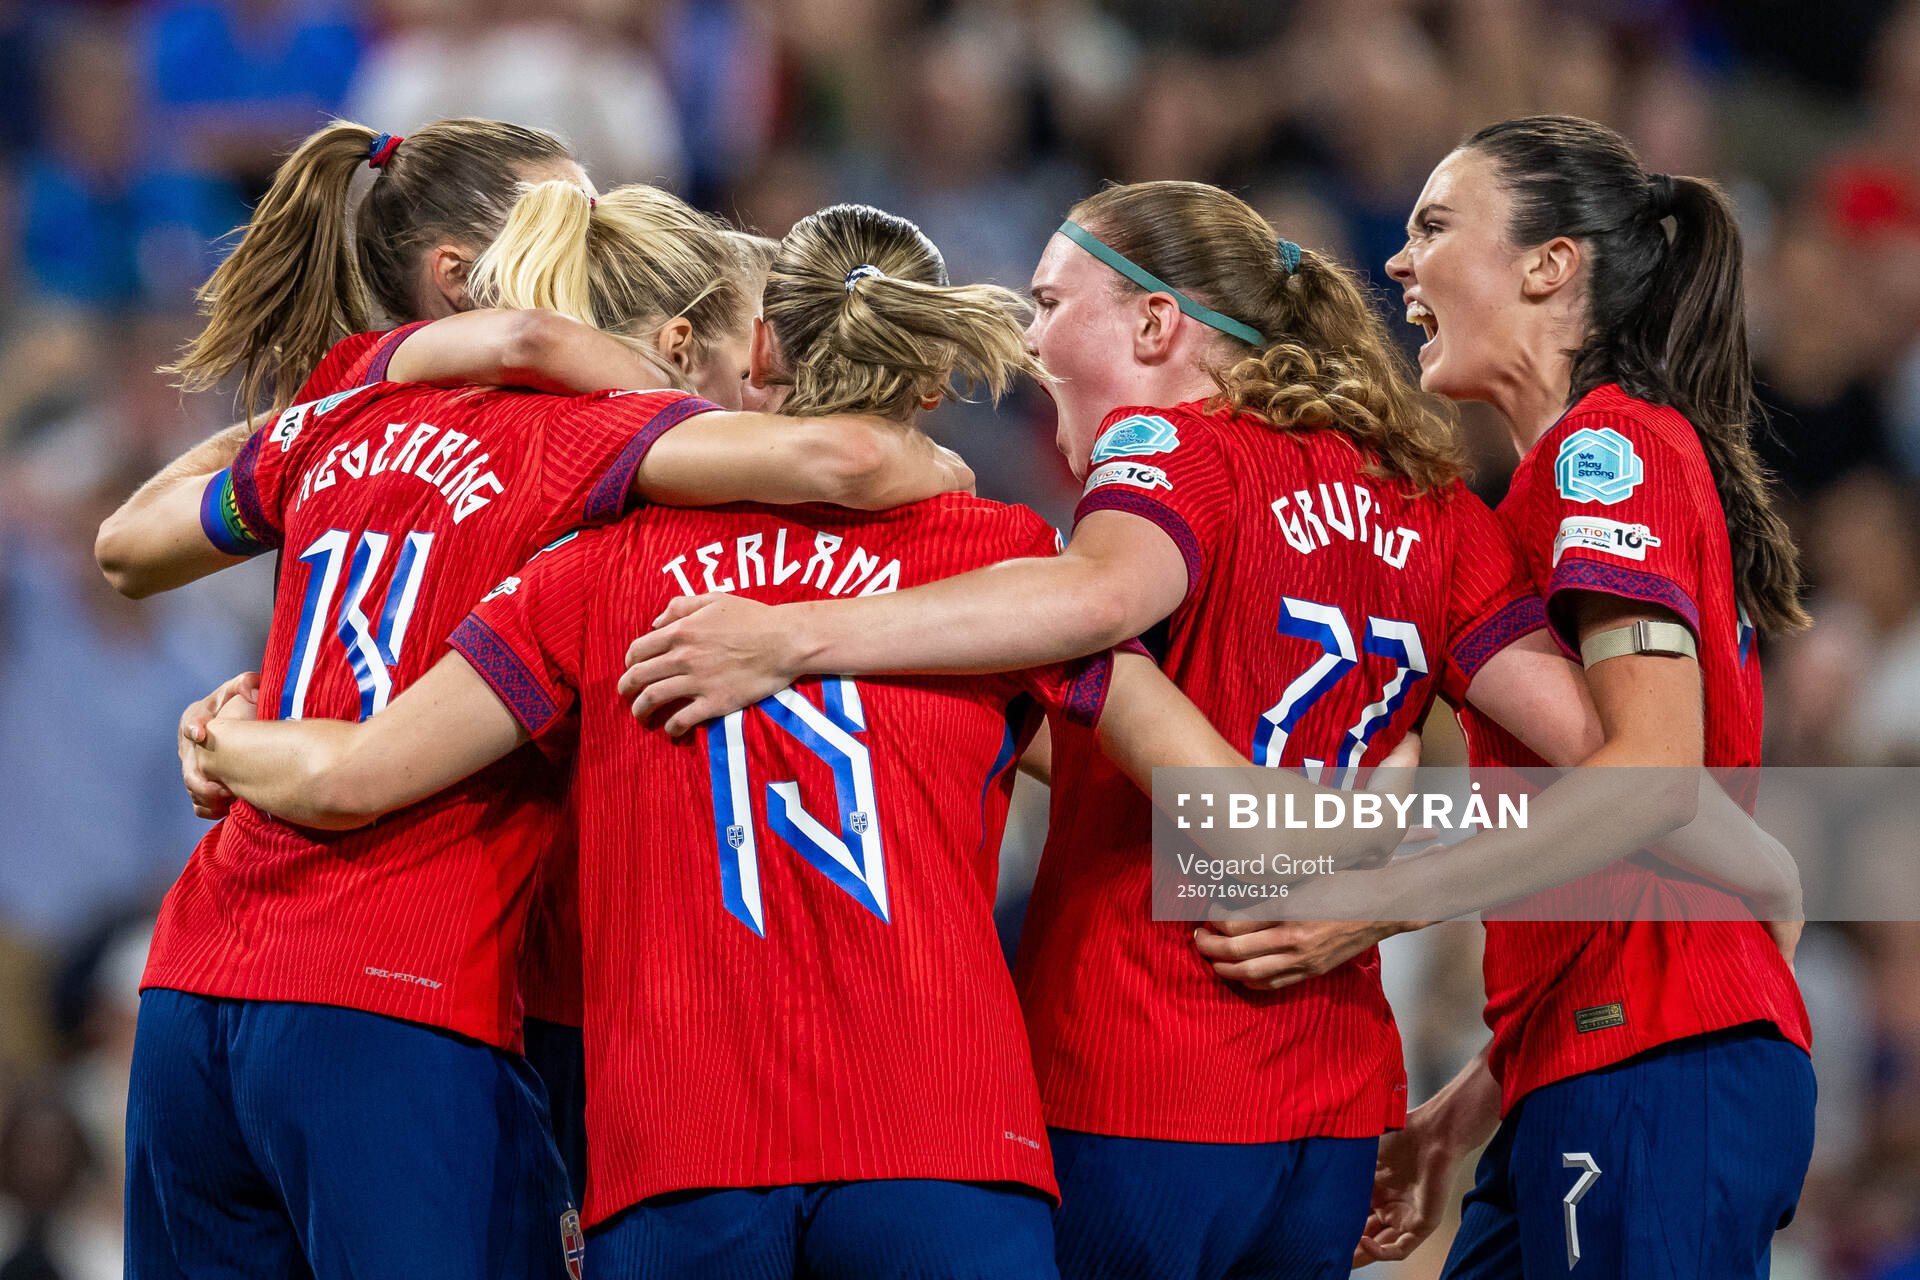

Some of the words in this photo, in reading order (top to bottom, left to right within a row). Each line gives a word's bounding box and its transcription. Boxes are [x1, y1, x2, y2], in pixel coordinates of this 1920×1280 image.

[1578, 461, 1602, 471] Play
[1578, 469, 1615, 480] Strong
[1614, 528, 1643, 549] 10
[279, 528, 435, 723] 14
[1562, 1152, 1602, 1272] 7
